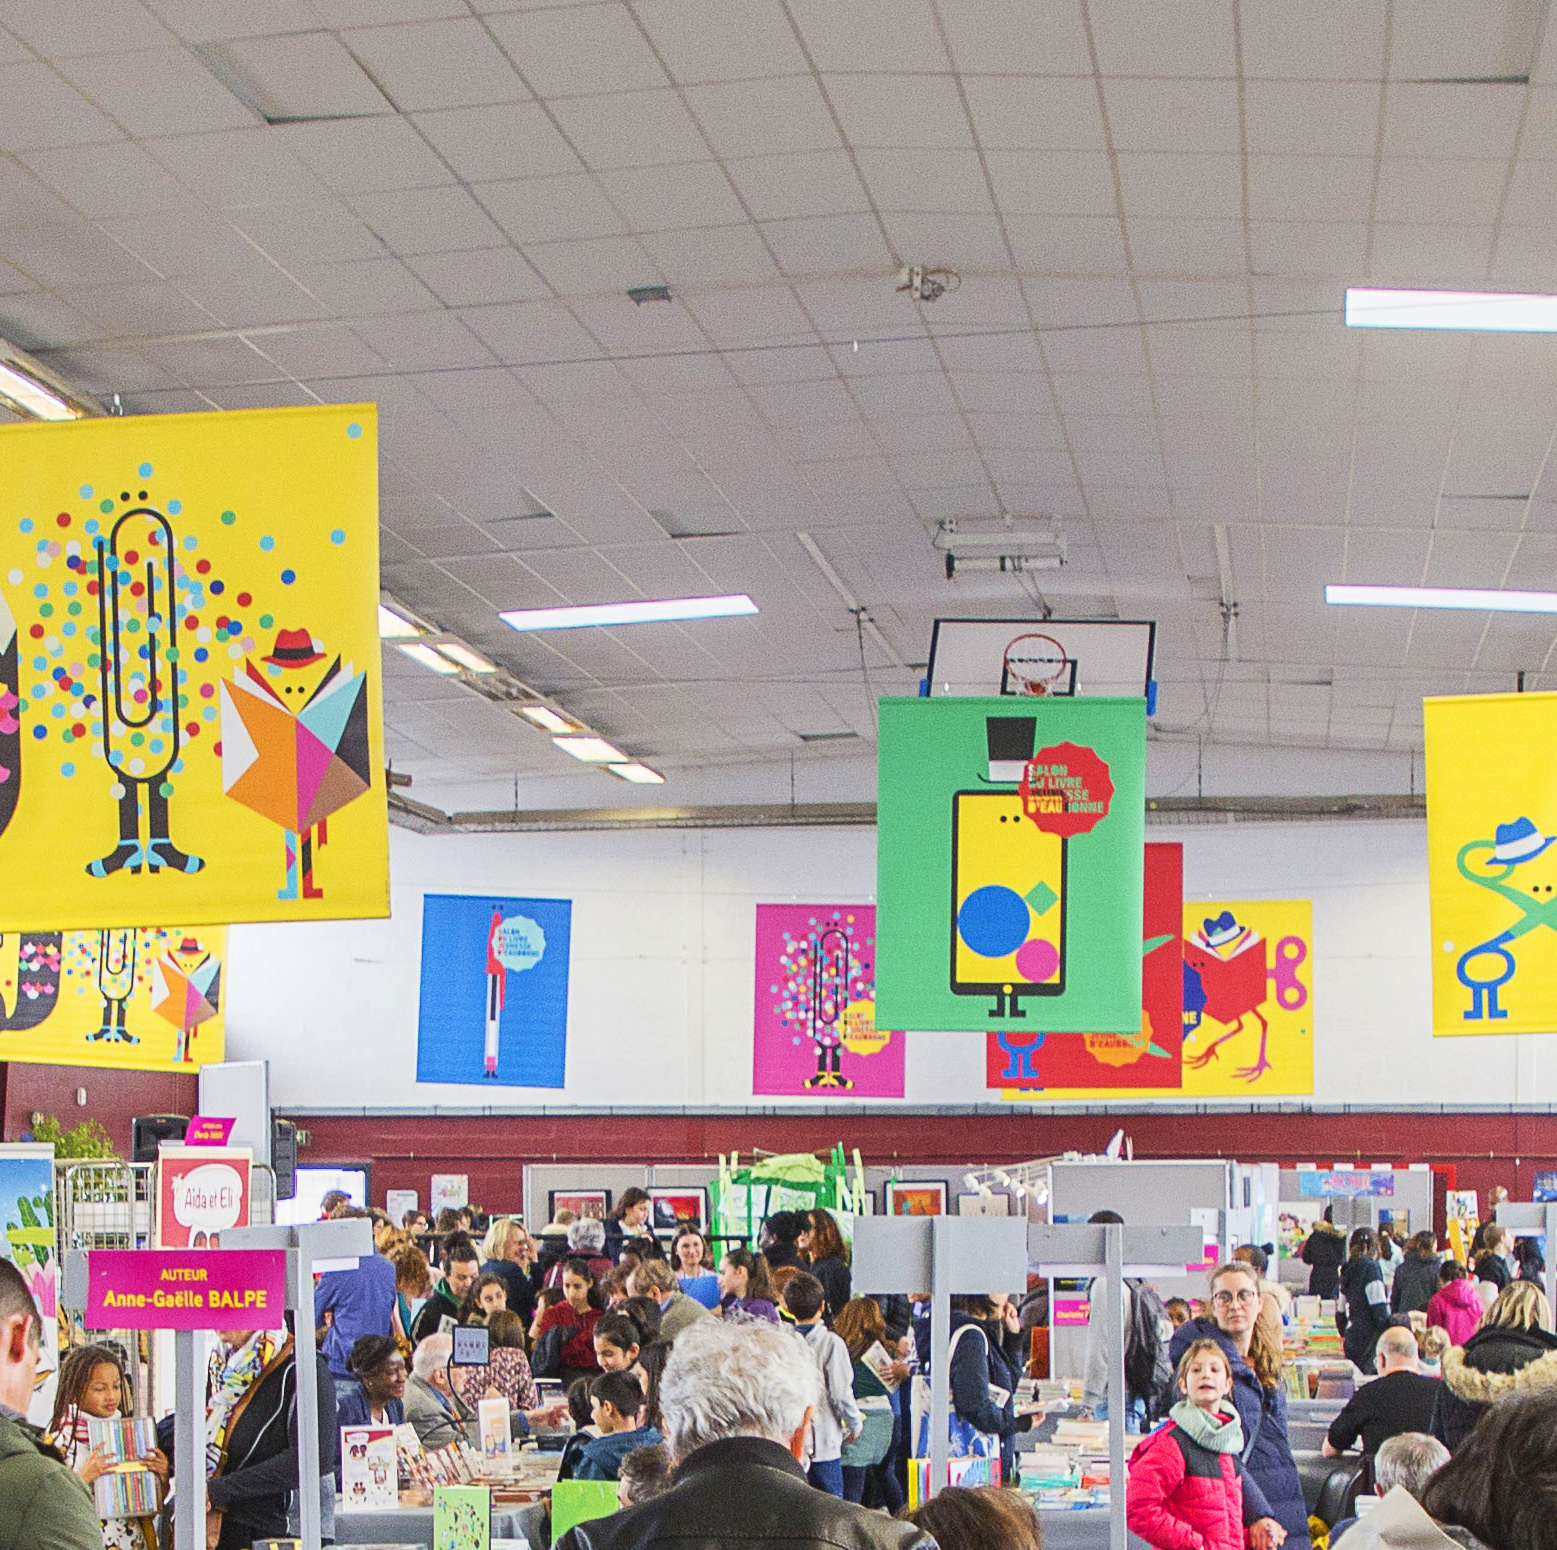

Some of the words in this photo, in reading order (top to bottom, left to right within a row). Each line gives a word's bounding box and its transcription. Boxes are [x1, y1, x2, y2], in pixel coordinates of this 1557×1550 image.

[185, 1187, 207, 1210] Aïda
[209, 1189, 218, 1209] et
[220, 1186, 233, 1209] Eli
[160, 1268, 208, 1282] AUTEUR
[103, 1289, 203, 1308] Anne-Gaëlle
[208, 1290, 267, 1308] BALPE
